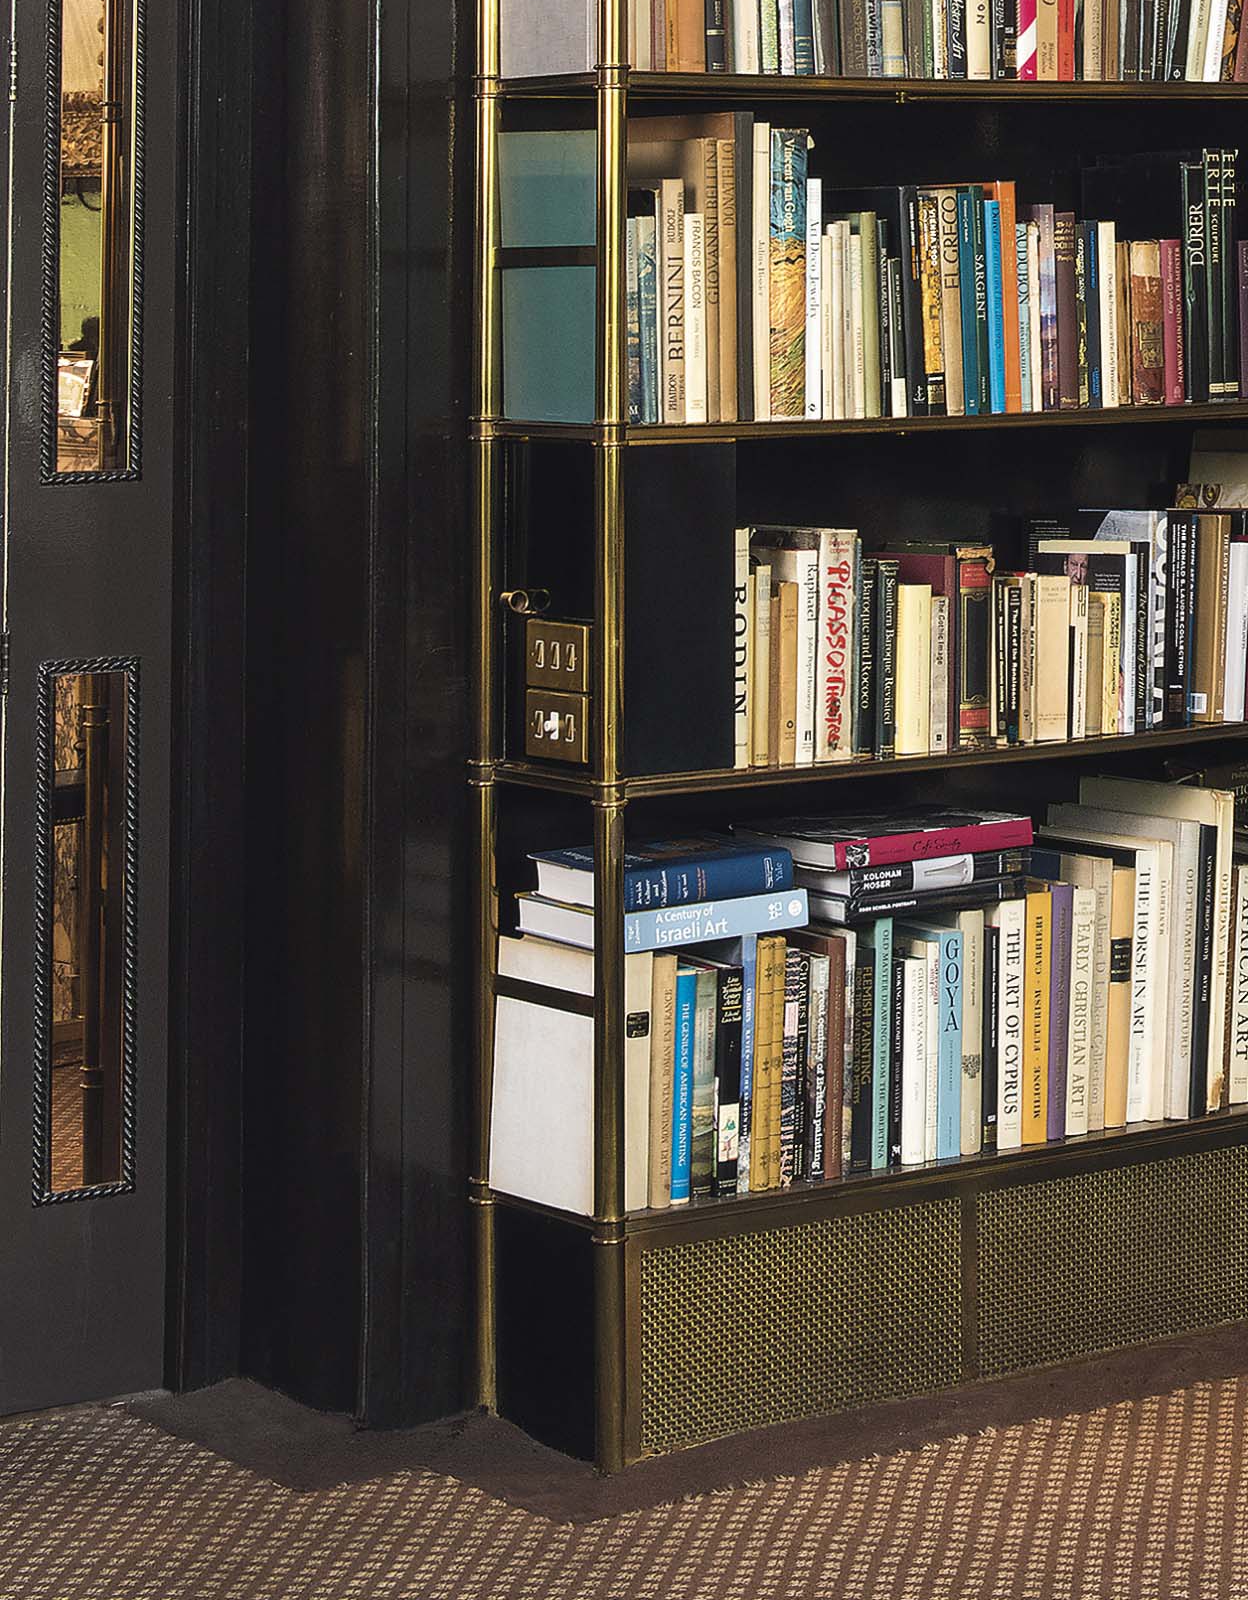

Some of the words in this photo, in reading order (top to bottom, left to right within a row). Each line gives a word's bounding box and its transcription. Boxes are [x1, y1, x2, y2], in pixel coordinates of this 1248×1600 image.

[784, 139, 796, 179] Vincent
[1207, 155, 1220, 208] ERTE
[1222, 155, 1236, 208] ERTE
[722, 143, 733, 226] DONATELLO
[784, 180, 796, 199] van
[667, 208, 676, 243] RUDOLF
[692, 220, 702, 266] FRANCIS
[940, 195, 957, 263] GRECO
[1188, 203, 1204, 266] DÜRER
[1211, 214, 1219, 264] SCULPTURE
[706, 216, 719, 305] GIOVANNI
[1016, 230, 1028, 305] AUDUBON
[668, 256, 684, 360] BERNINI
[692, 269, 702, 309] BACON
[975, 254, 986, 320] SARGENT
[860, 576, 873, 634] Baroque
[884, 580, 896, 628] Southern
[936, 601, 945, 611] The
[734, 583, 747, 716] RODIN
[861, 636, 872, 659] and
[883, 630, 894, 676] Baroque
[936, 641, 944, 665] Image
[860, 662, 872, 709] Rococo
[864, 870, 901, 880] KOLOMAN
[864, 880, 891, 889] MOSER
[656, 923, 701, 943] Israeli
[704, 919, 728, 935] Art
[665, 909, 699, 922] Century
[702, 906, 712, 916] of
[1008, 929, 1021, 965] THE
[1076, 919, 1092, 972] EARLY
[800, 960, 809, 1018] CHARLES
[864, 967, 872, 1014] FLEMISH
[944, 937, 961, 1032] GOYA
[1007, 972, 1019, 1008] ART
[1006, 1015, 1019, 1039] OF
[1034, 990, 1042, 1051] FUTURISM
[1073, 978, 1089, 1065] CHRISTIAN
[1133, 1005, 1145, 1039] ART
[861, 1018, 872, 1085] PAINTING
[1004, 1044, 1018, 1114] CYPRUS
[1072, 1071, 1086, 1104] ART
